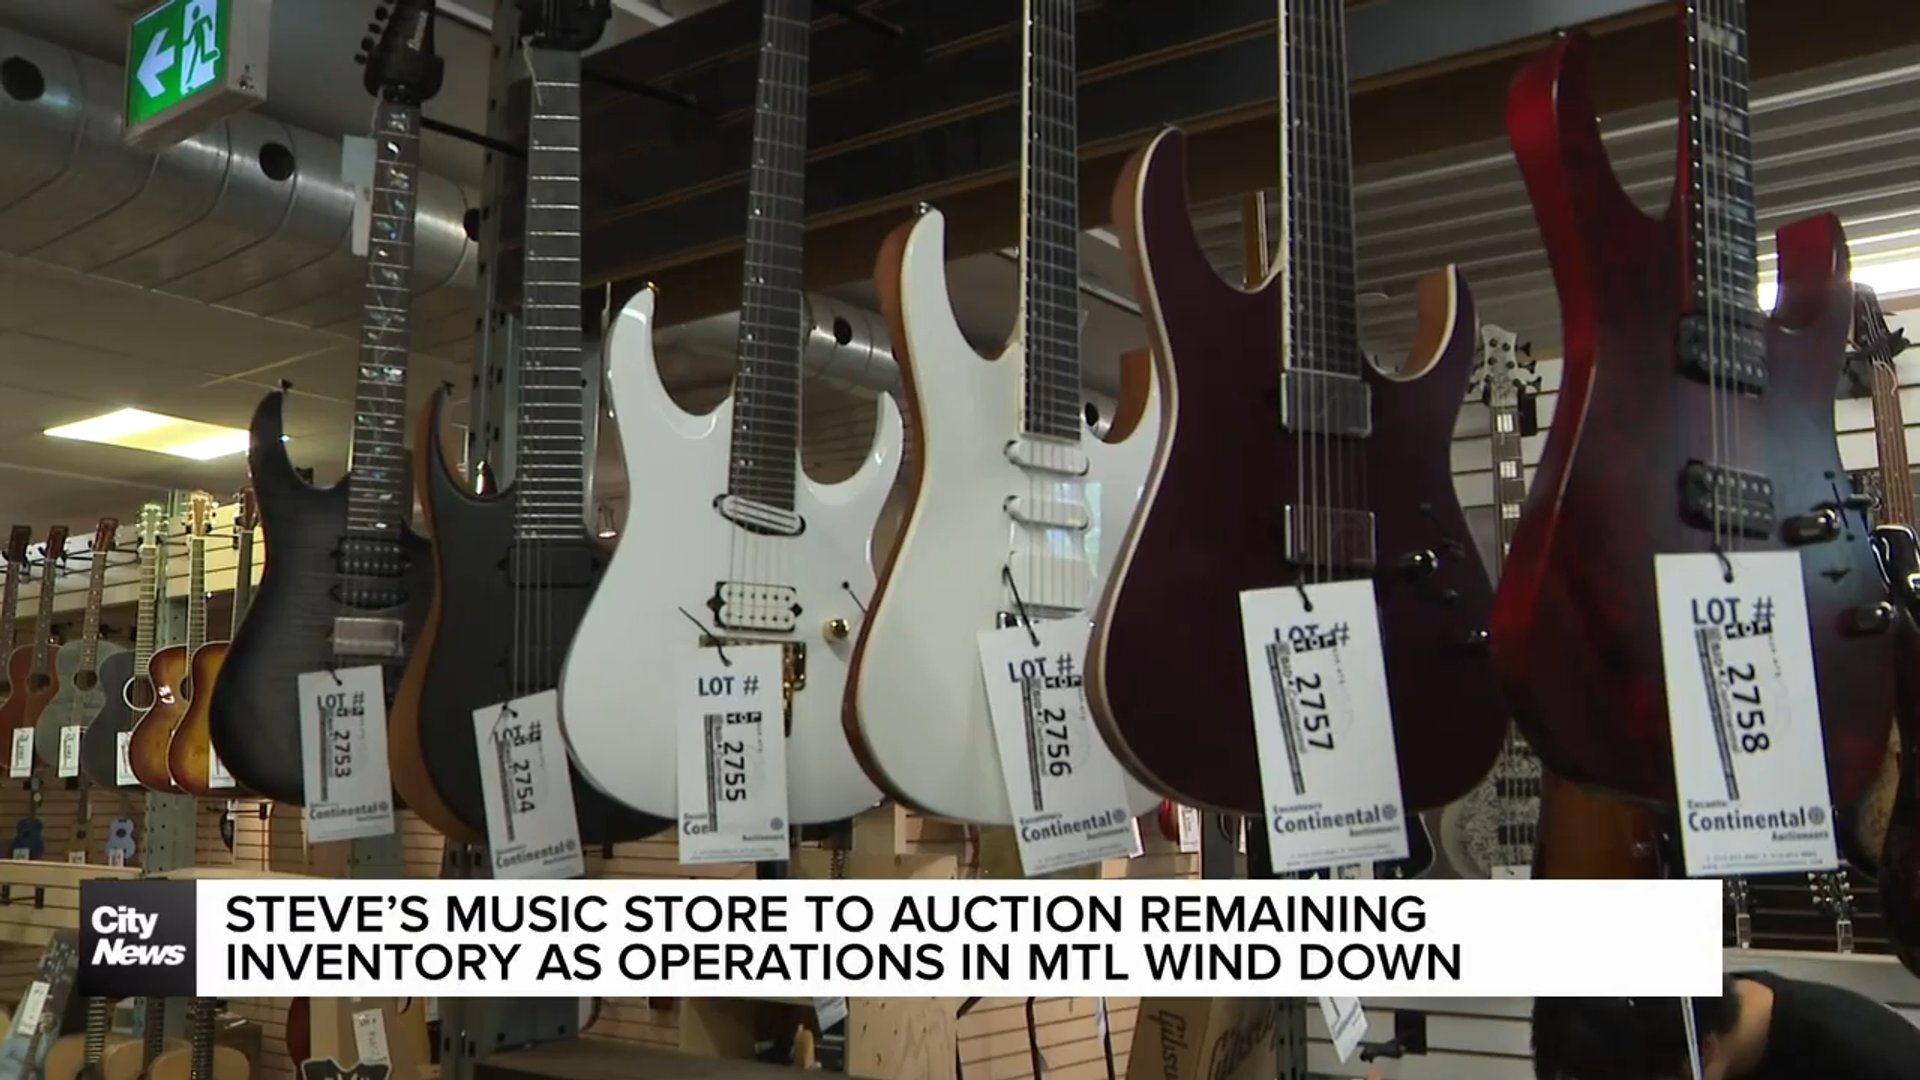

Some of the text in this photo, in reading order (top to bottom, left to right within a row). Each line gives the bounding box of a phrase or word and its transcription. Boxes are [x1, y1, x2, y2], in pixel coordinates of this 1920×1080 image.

[1691, 596, 1774, 625] LOT #
[1008, 657, 1047, 683] LOT
[1057, 653, 1075, 676] #
[699, 675, 759, 697] LOT #
[1296, 673, 1334, 749] 2757
[1727, 663, 1770, 753] 2758
[333, 730, 352, 779] 2753
[1043, 708, 1072, 777] 2756
[512, 759, 536, 814] 2754
[724, 741, 746, 802] 2755
[310, 802, 377, 821] Continental
[1021, 810, 1112, 843] Continental
[1274, 804, 1381, 834] Continental
[1688, 806, 1806, 832] Continental
[496, 841, 565, 869] Continental
